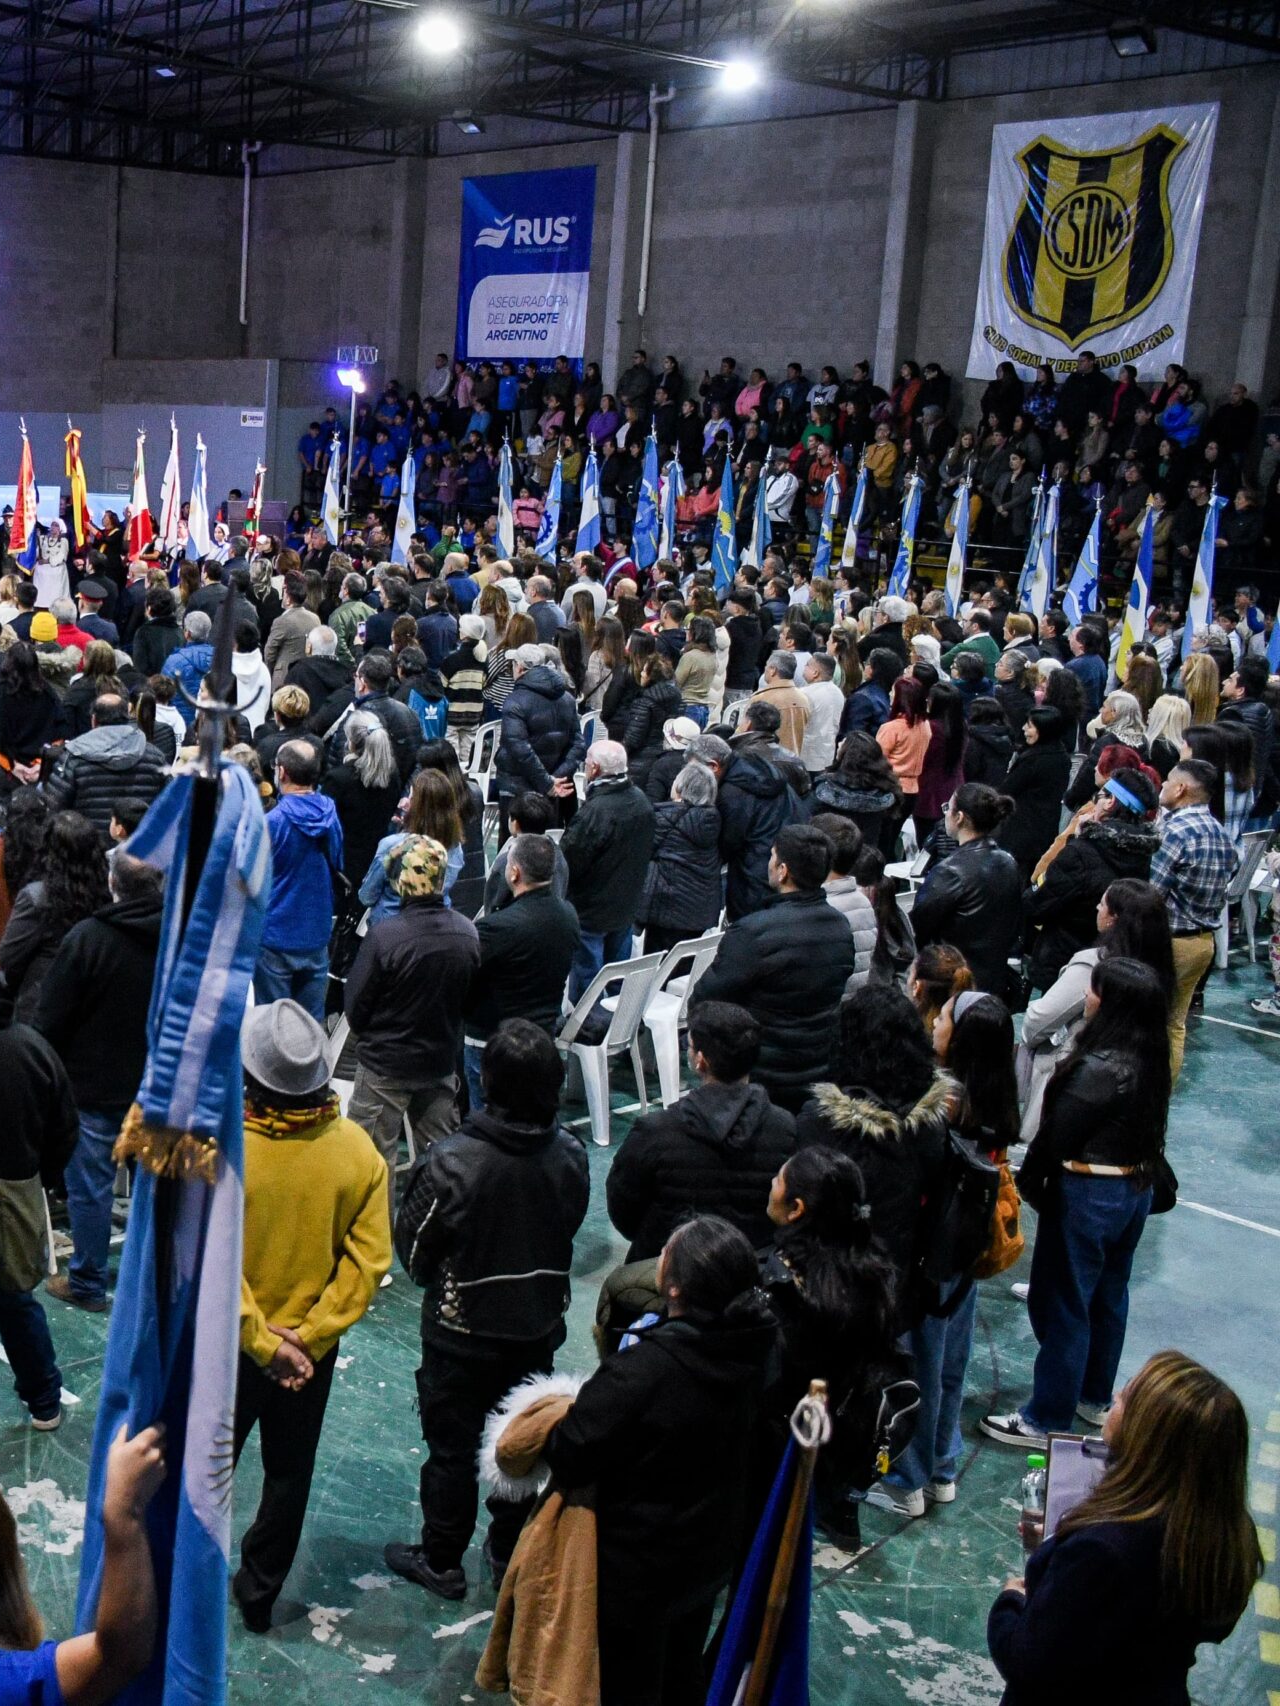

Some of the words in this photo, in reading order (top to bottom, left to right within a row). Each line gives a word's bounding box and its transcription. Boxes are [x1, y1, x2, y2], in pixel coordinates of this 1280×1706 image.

[514, 216, 570, 245] RUS
[1051, 193, 1124, 268] CSDM
[487, 295, 569, 308] ASEGURADORA
[487, 313, 505, 324] DEL
[509, 313, 559, 324] DEPORTE
[485, 330, 548, 341] ARGENTINO
[1006, 344, 1042, 368] SOCIAL
